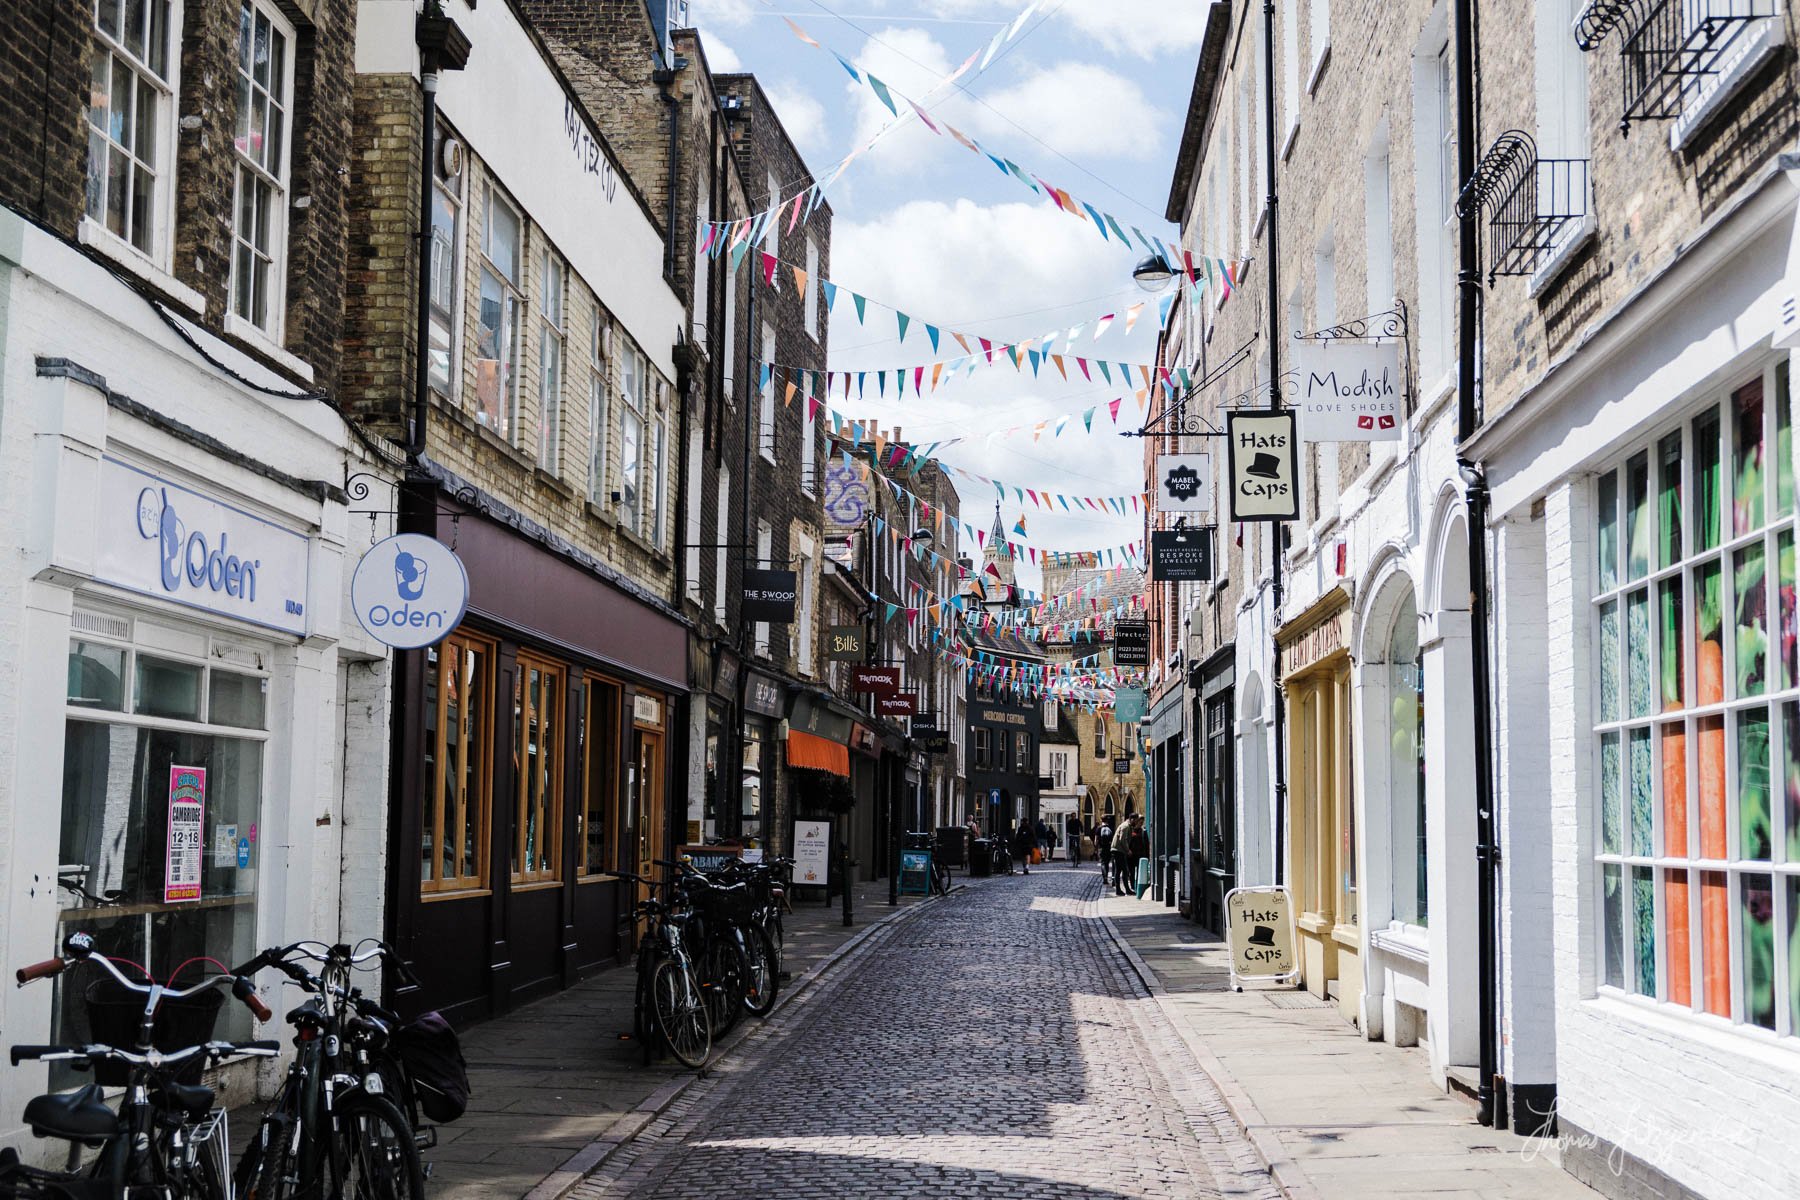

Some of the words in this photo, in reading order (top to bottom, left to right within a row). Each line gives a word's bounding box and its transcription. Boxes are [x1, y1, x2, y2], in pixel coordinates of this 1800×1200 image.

[1308, 366, 1393, 399] Modish
[1308, 404, 1341, 412] LOVE
[1351, 403, 1395, 411] SHOES
[1240, 432, 1286, 448] Hats
[1240, 480, 1288, 499] Caps
[186, 531, 257, 602] Oden
[744, 590, 759, 598] THE
[762, 591, 795, 600] SWOOP
[369, 603, 442, 628] Oden
[834, 635, 859, 652] Bill's
[1289, 633, 1310, 672] LAIRD
[1312, 608, 1343, 661] HATTERS
[172, 806, 201, 822] CAMBRIDGE
[173, 832, 183, 842] 12
[189, 832, 198, 843] 18
[688, 856, 730, 868] ABANC
[1242, 909, 1279, 922] Hats
[1244, 947, 1282, 963] Caps
